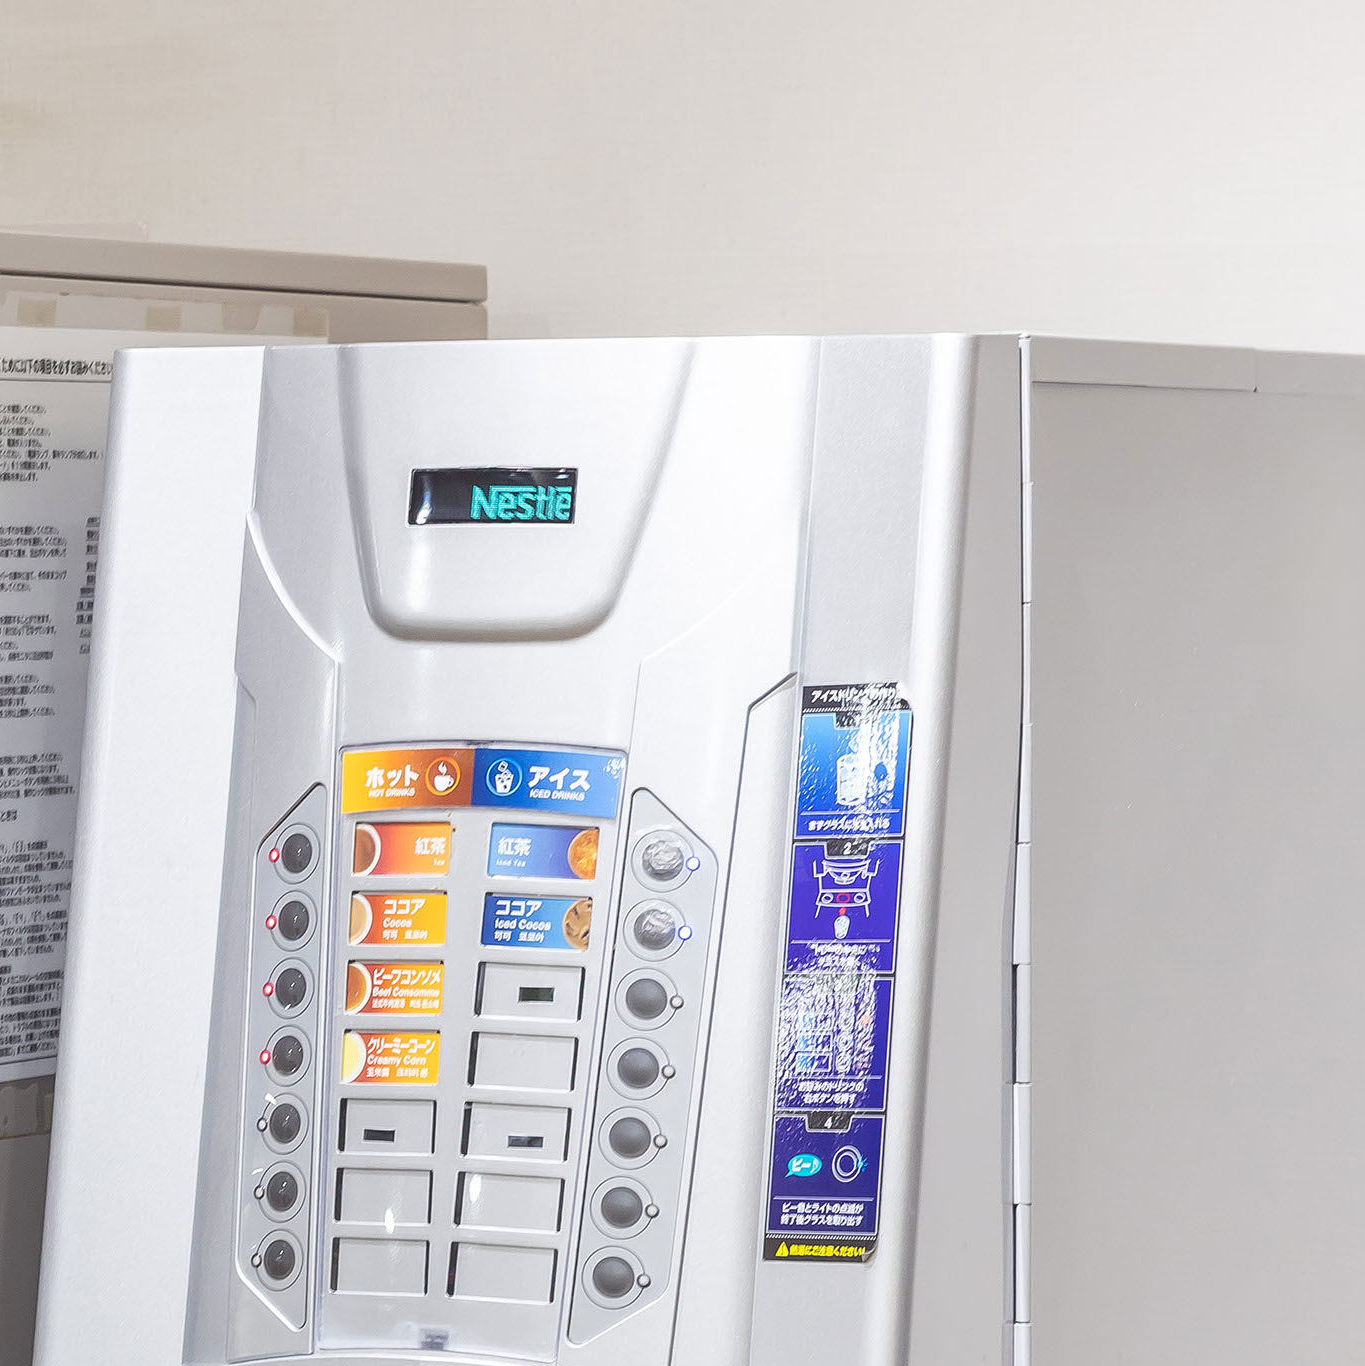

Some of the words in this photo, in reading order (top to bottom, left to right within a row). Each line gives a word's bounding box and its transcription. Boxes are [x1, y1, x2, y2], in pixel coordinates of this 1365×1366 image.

[470, 485, 573, 521] Nestlé
[364, 764, 420, 789] ホット
[527, 765, 591, 792] アイス
[368, 788, 384, 798] HOT
[385, 787, 417, 798] DRINKS
[529, 790, 550, 800] ICED
[551, 791, 585, 802] DRINKS
[414, 836, 447, 856] 紅茶
[497, 836, 532, 857] 紅茶
[383, 898, 426, 915] ココア
[495, 900, 543, 917] ココア
[383, 916, 413, 928] Cocoa
[495, 918, 517, 930] Iced
[518, 918, 552, 931] Cocoa
[373, 968, 441, 986] ビーフコンソメ
[372, 986, 391, 998] Beef
[367, 1036, 436, 1054] クリーミーコーン
[367, 1054, 402, 1068] Creamy
[403, 1054, 427, 1066] Corn
[823, 1116, 833, 1129] 4
